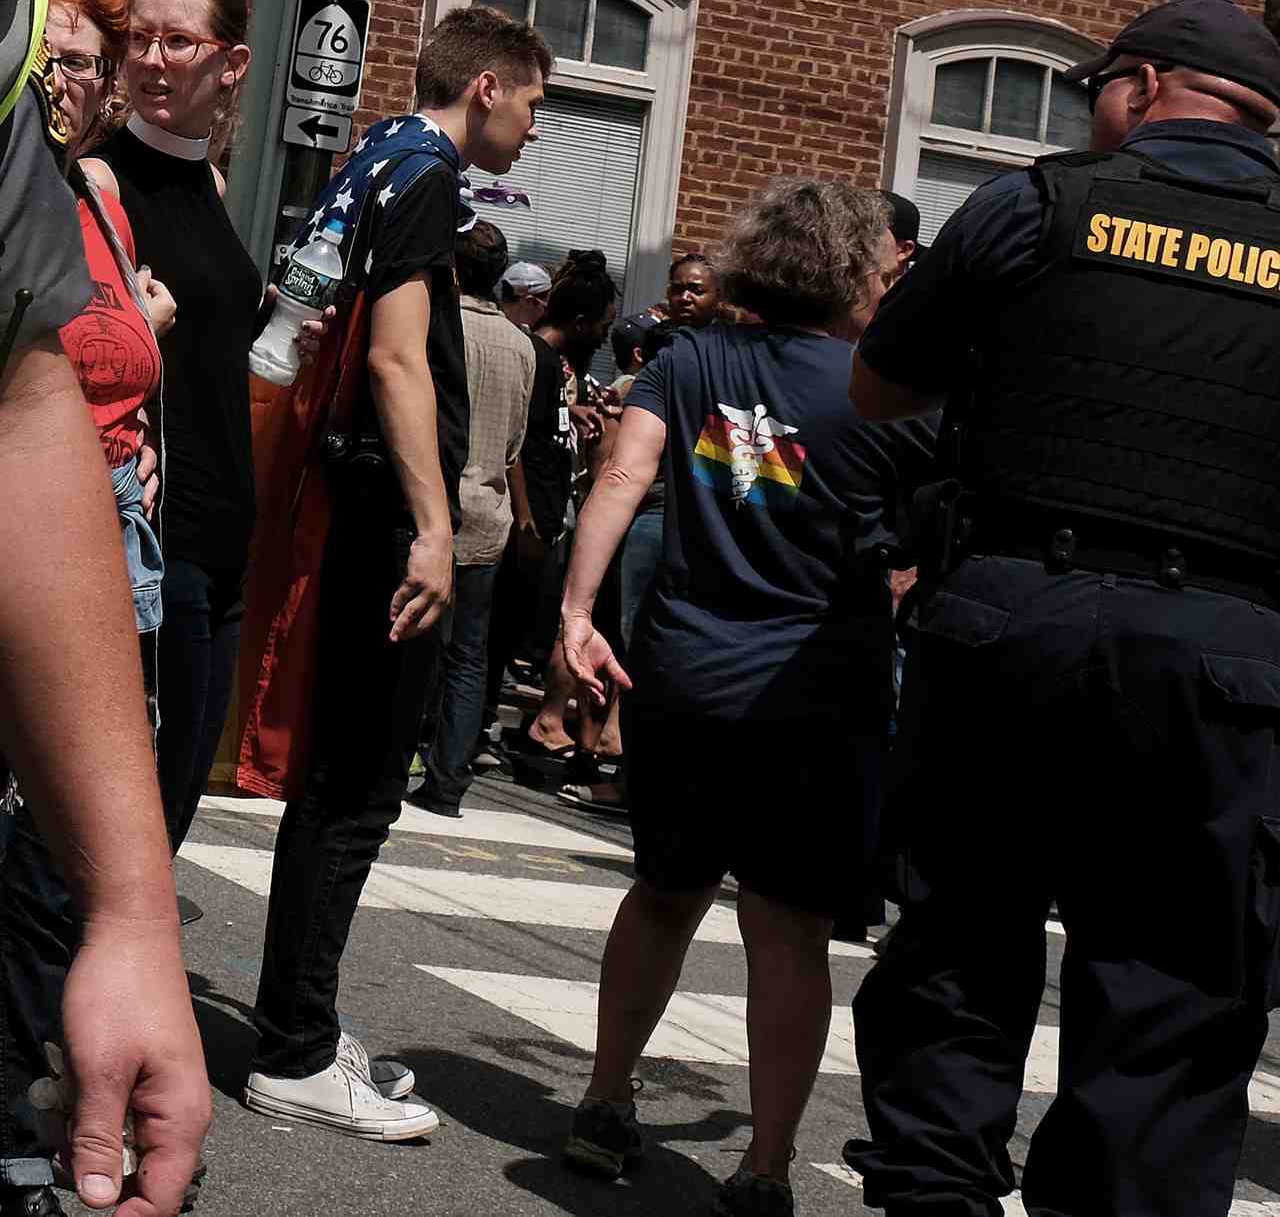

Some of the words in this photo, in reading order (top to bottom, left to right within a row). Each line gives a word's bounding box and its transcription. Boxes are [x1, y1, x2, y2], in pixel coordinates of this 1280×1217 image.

[313, 19, 349, 54] 76
[1086, 213, 1184, 268] STATE
[1185, 232, 1280, 291] POLIC
